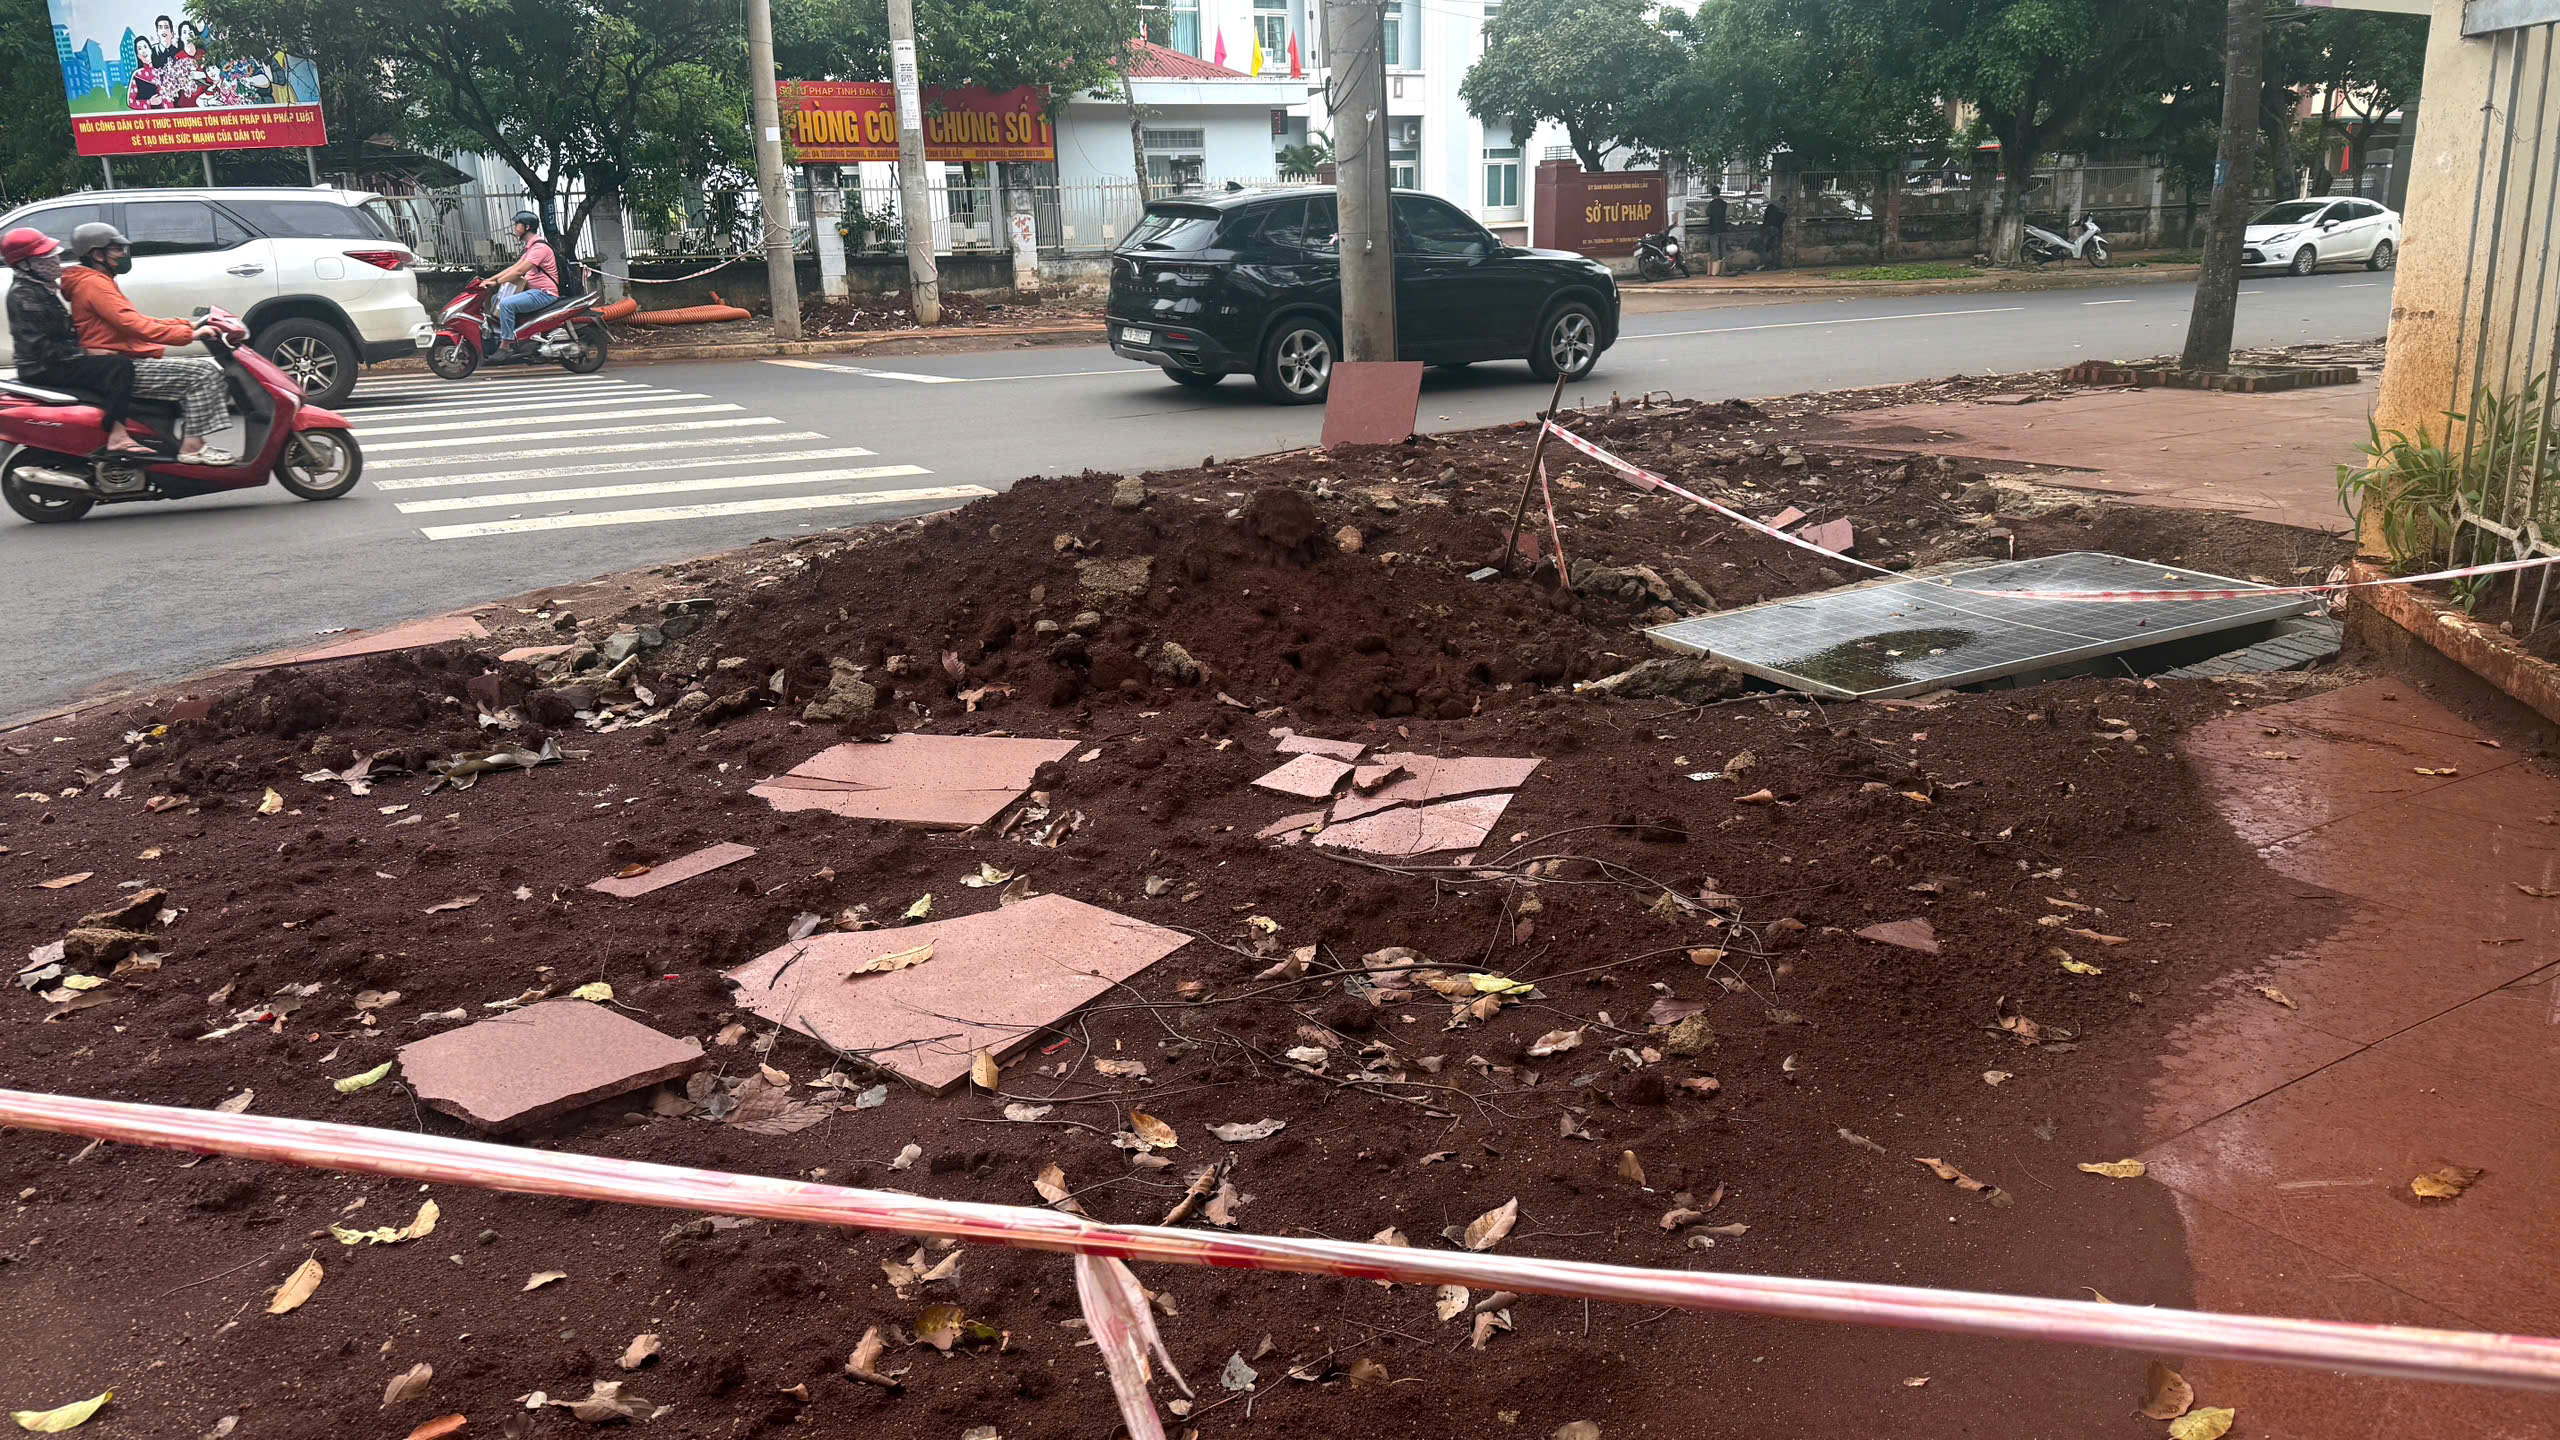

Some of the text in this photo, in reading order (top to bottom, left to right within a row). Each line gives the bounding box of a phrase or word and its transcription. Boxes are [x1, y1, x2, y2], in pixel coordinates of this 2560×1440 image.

[95, 120, 116, 132] CÔNG
[117, 118, 133, 131] DÂN
[134, 117, 145, 130] CÓ
[152, 116, 172, 129] THỨC
[173, 115, 202, 130] THƯỢNG
[203, 113, 219, 126] TÔN
[220, 112, 239, 125] HIẾN
[239, 112, 260, 125] PHÁP
[261, 111, 273, 124] VÀ
[273, 110, 294, 123] PHÁP
[296, 110, 315, 124] LUẬT
[928, 102, 1001, 144] CHỨNG
[1005, 95, 1033, 144] SỐ
[131, 128, 266, 147] SẼ TẠO NÊN SỨC MẠNH CỦA DÂN TỘC
[1585, 199, 1652, 223] SỞ TƯ PHÁP
